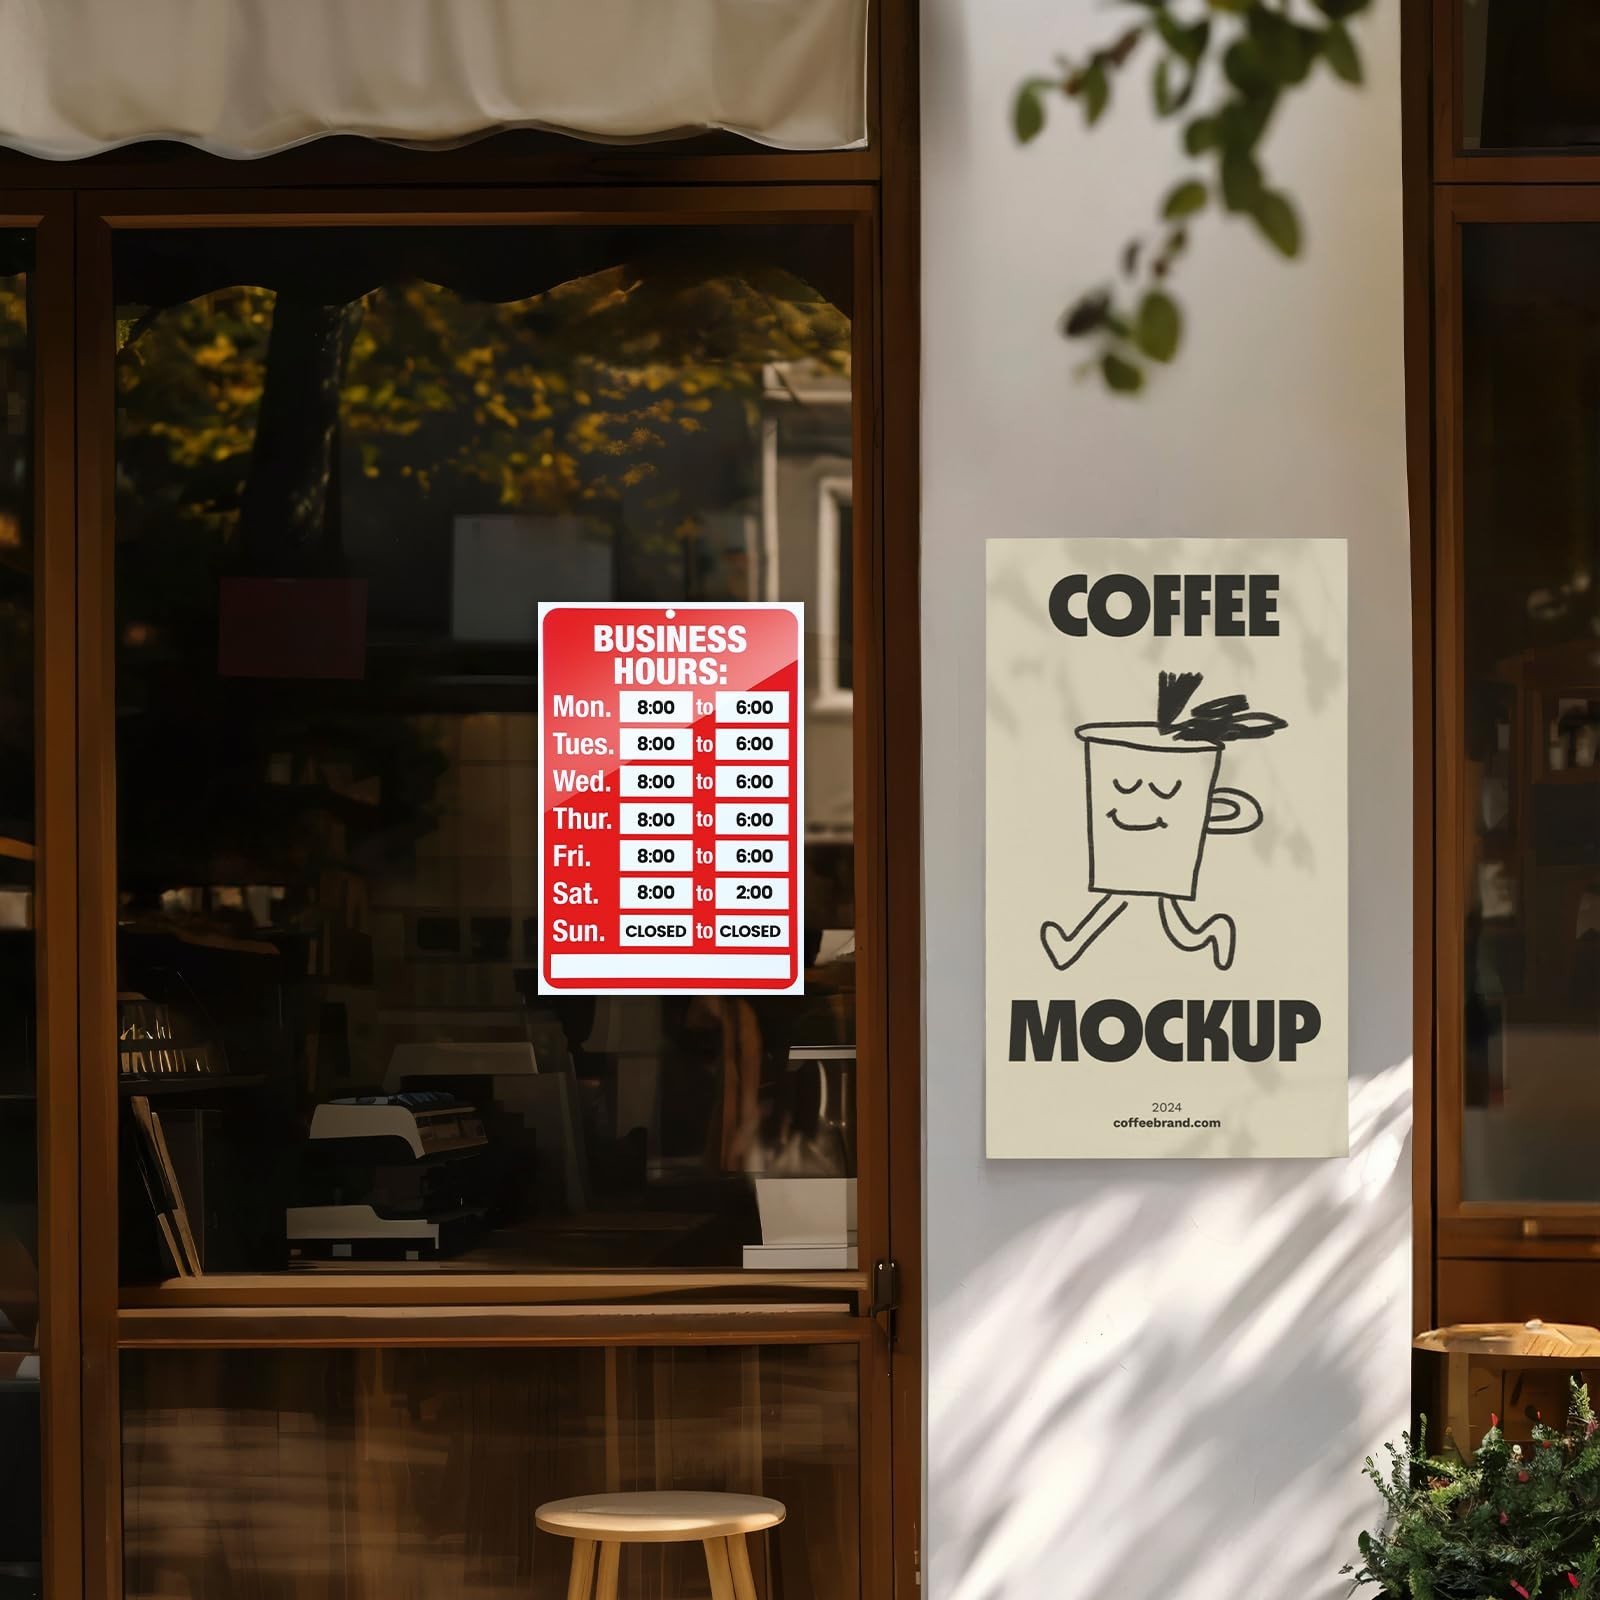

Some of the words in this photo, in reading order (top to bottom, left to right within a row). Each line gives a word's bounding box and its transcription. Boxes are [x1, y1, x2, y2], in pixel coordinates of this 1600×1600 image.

[1049, 574, 1279, 637] COFFEE
[595, 625, 747, 653] BUSINESS
[615, 658, 727, 685] HOURS:
[554, 695, 610, 717] Mon.
[638, 700, 674, 714] 8:00
[696, 699, 713, 715] to
[737, 700, 773, 714] 6:00
[553, 733, 613, 755] Tues.
[638, 736, 674, 750] 8:00
[696, 737, 713, 752] to
[737, 736, 773, 750] 6:00
[553, 770, 610, 792] Wed.
[638, 774, 674, 789] 8:00
[696, 774, 713, 789] to
[737, 775, 773, 788] 6:00
[553, 808, 611, 829] Thur.
[638, 813, 674, 827] 8:00
[696, 812, 712, 826] to
[737, 813, 773, 827] 6:00
[554, 845, 590, 866] Fri.
[638, 849, 674, 863] 8:00
[696, 848, 712, 863] to
[737, 849, 773, 863] 6:00
[554, 882, 597, 904] Sat.
[638, 885, 674, 899] 8:00
[696, 886, 713, 901] to
[737, 885, 772, 899] 2:00
[553, 920, 604, 941] Sun.
[626, 925, 686, 937] CLOSED
[696, 923, 713, 938] to
[720, 925, 780, 937] CLOSED
[1009, 999, 1321, 1062] MOCKUP
[1151, 1102, 1182, 1113] 2024
[1113, 1117, 1221, 1128] coffeebrand.com
